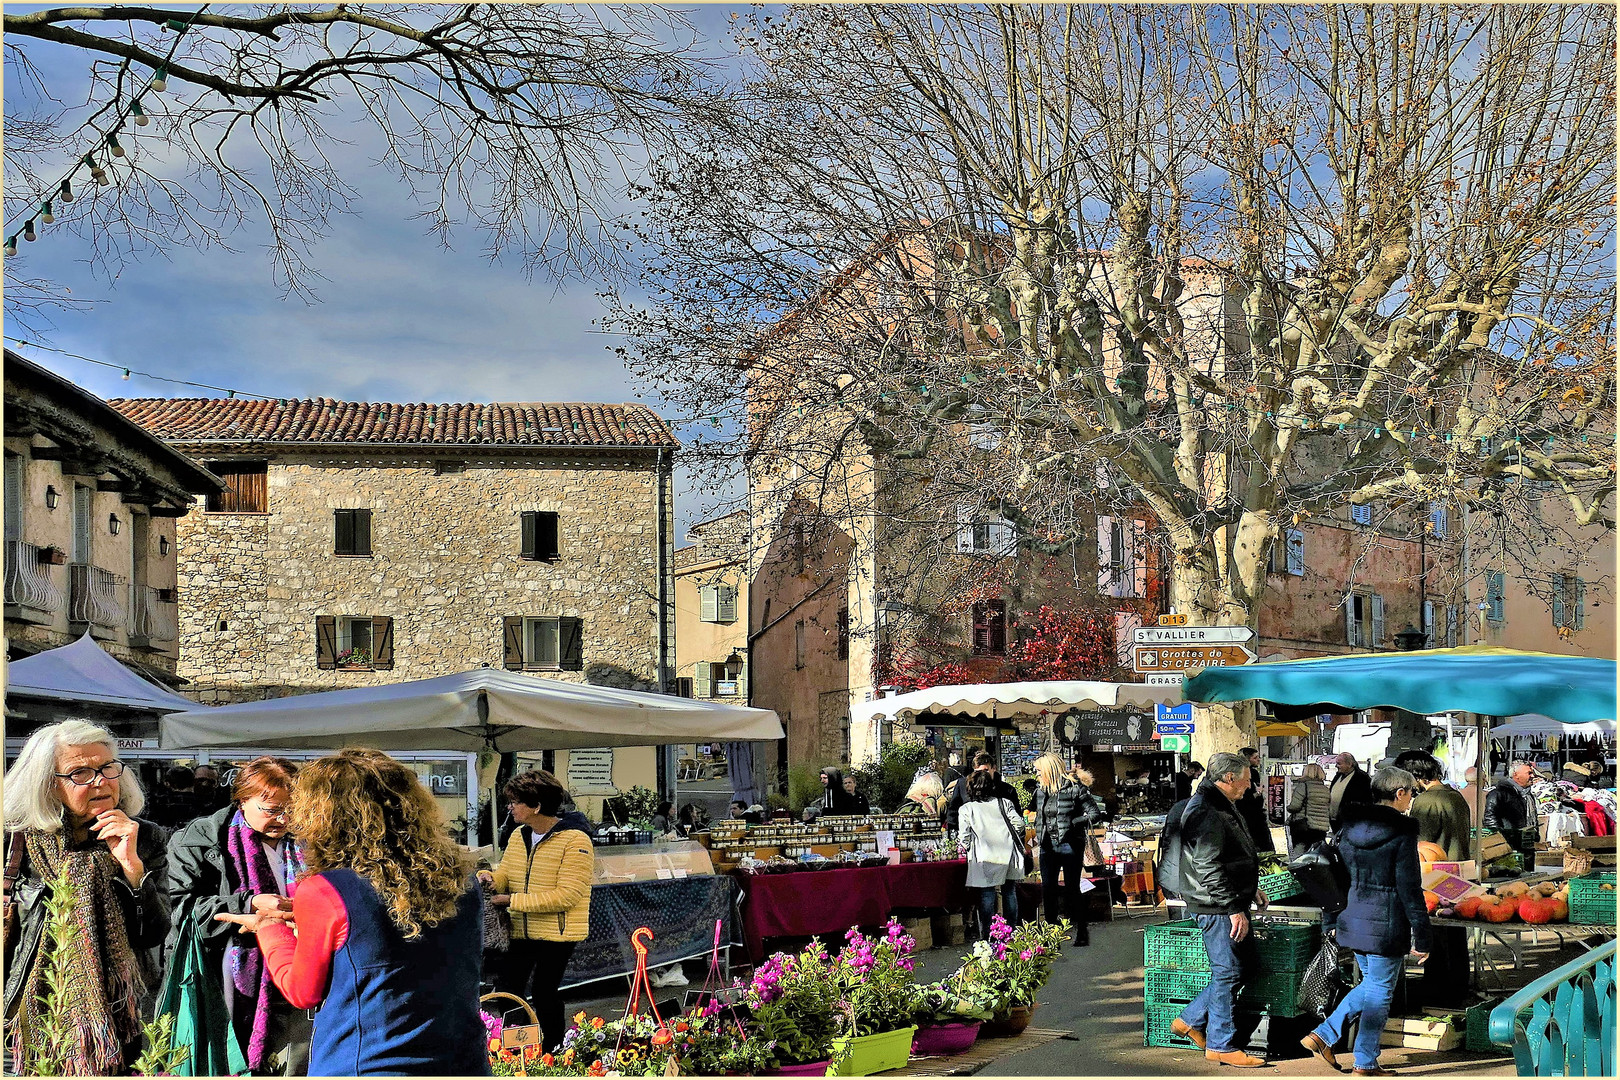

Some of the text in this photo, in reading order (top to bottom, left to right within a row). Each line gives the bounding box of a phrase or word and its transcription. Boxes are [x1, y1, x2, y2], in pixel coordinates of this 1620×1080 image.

[1162, 615, 1185, 625] D 13
[1156, 631, 1205, 639] VALLIER
[1161, 649, 1222, 658] Grottes de
[1175, 659, 1226, 668] CEZAIRE
